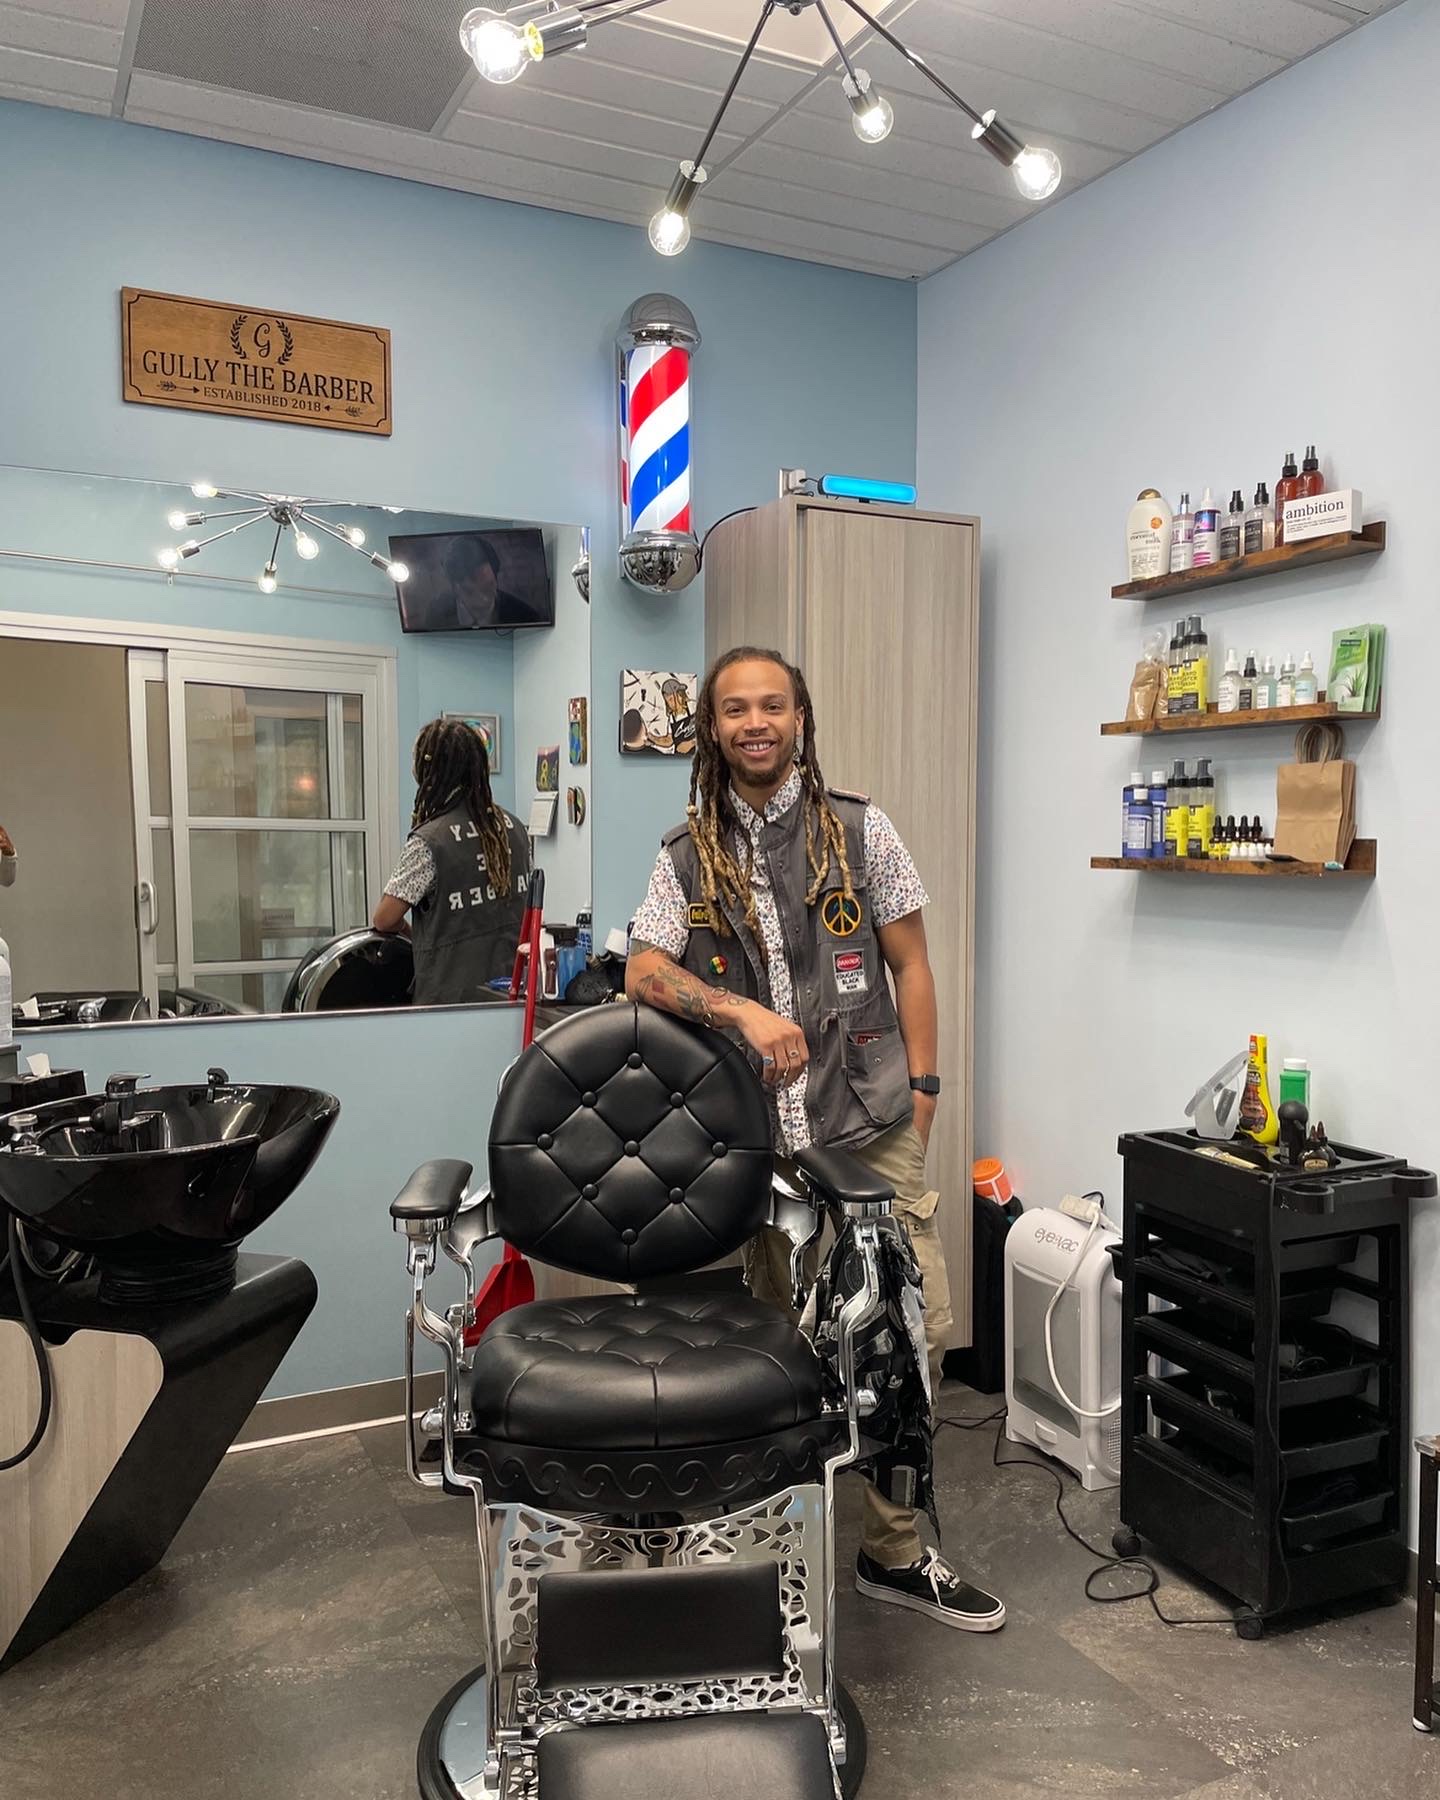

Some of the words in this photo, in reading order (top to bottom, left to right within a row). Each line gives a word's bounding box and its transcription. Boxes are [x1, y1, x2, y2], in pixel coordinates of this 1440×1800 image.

[253, 322, 271, 358] G
[143, 350, 219, 382] GULLY
[226, 361, 275, 390] THE
[283, 370, 375, 405] BARBER
[203, 386, 288, 408] ESTABLISHED
[291, 399, 321, 413] 2018
[1285, 500, 1345, 520] ambition
